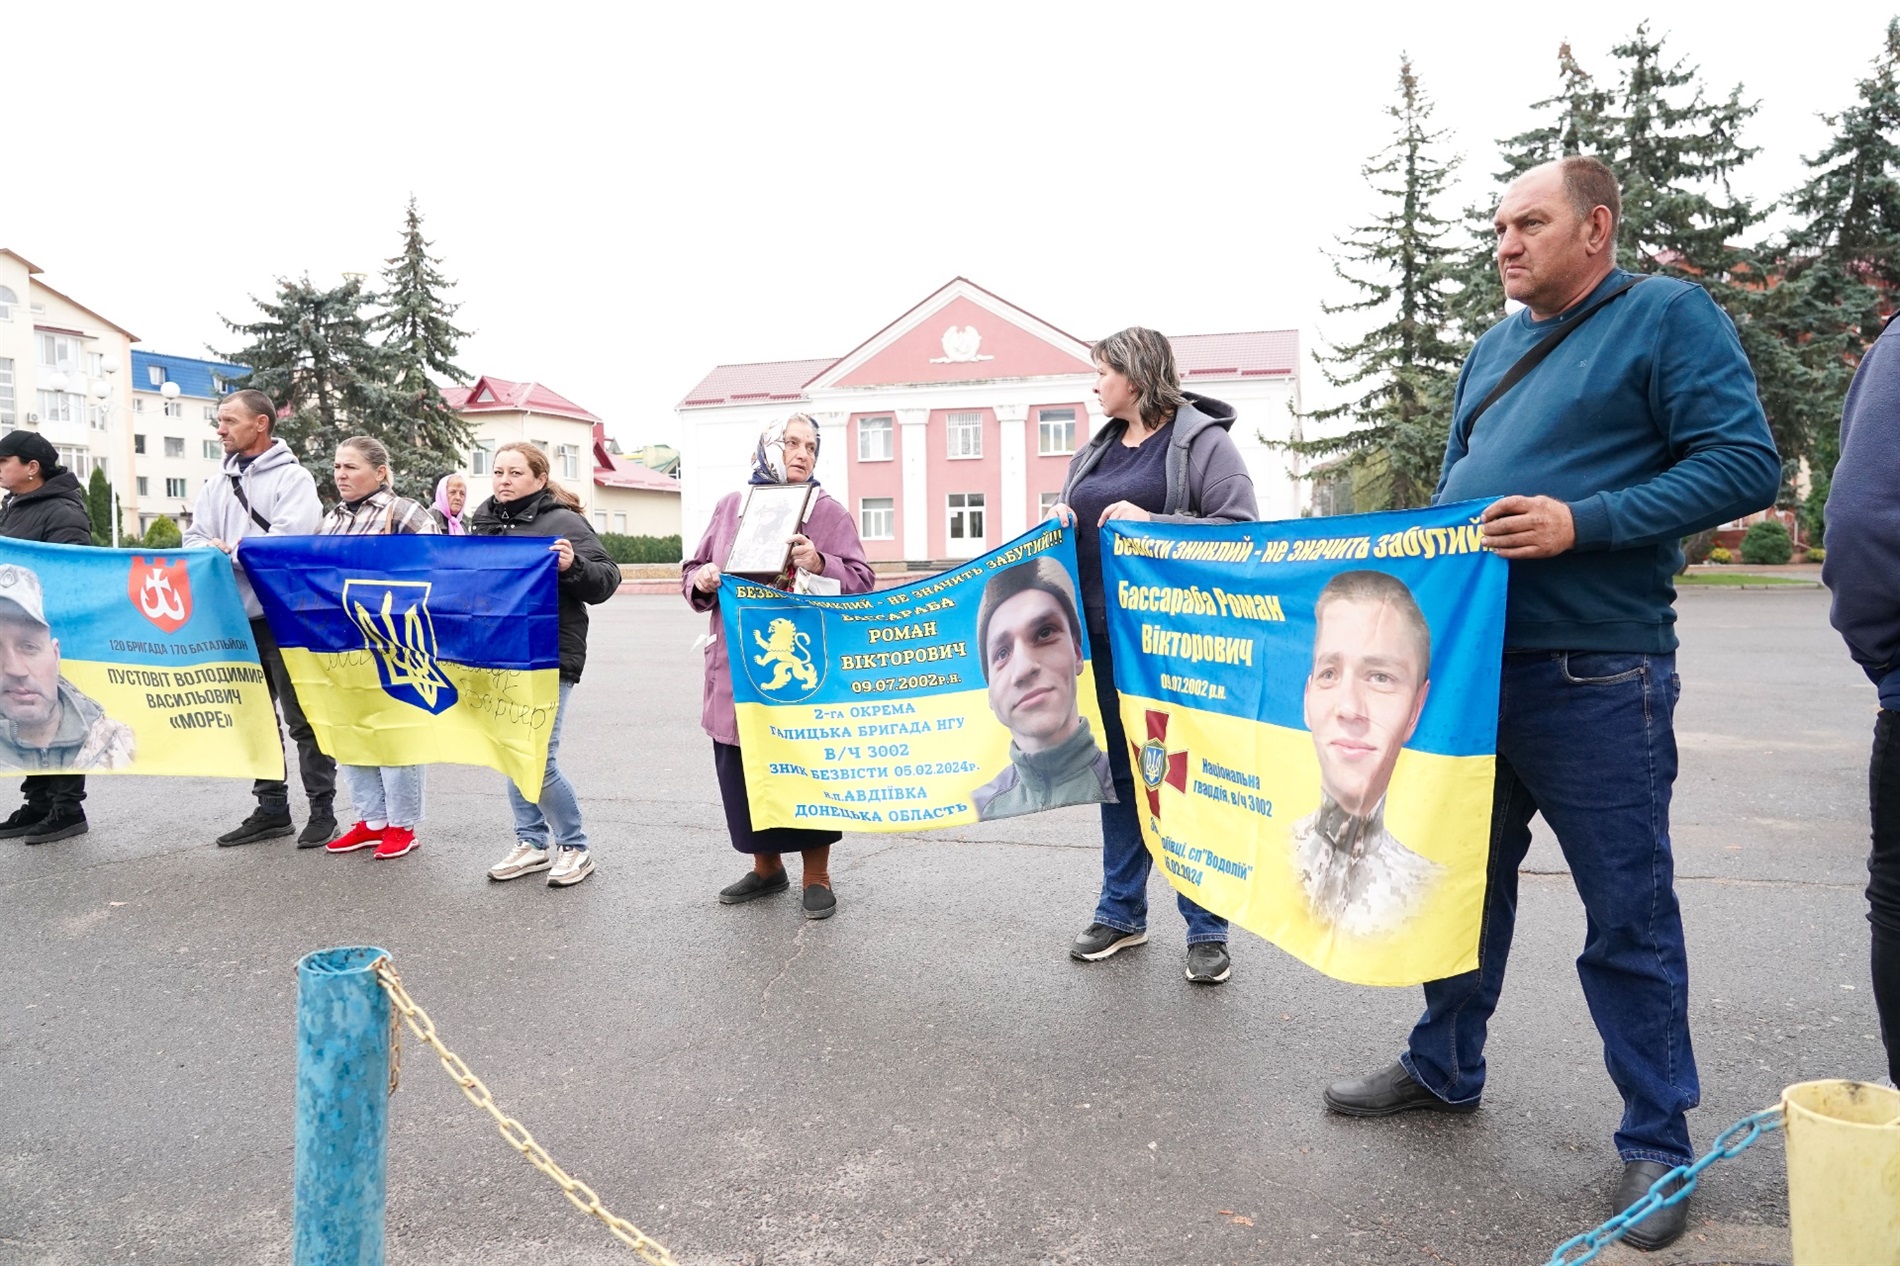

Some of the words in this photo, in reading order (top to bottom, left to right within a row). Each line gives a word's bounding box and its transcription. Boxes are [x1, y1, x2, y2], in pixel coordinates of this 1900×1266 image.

[1172, 535, 1254, 563] зниклий
[1260, 540, 1289, 563] не
[1287, 535, 1371, 562] значить
[887, 593, 910, 606] НЕ
[912, 566, 984, 599] ЗНАЧИТЬ
[986, 529, 1064, 570] ЗАБУТИЙ!!!
[1118, 580, 1217, 616] Бассараба
[1212, 587, 1286, 622] Роман
[868, 621, 938, 644] РОМАН
[109, 639, 125, 651] 120
[126, 641, 169, 656] БРИГАДА
[169, 644, 187, 655] 170
[190, 639, 249, 654] БАТАЛЬЙОН
[841, 642, 967, 670] ВІКТОРОВИЧ
[1141, 624, 1254, 667] Вікторович
[107, 668, 171, 688] ПУСТОВІТ
[174, 667, 264, 688] ВОЛОДИМИР
[1160, 673, 1209, 697] 09.07.2002
[1208, 683, 1227, 700] р.н.
[146, 689, 242, 709] ВАСИЛЬОВИЧ
[850, 702, 916, 718] ОКРЕМА
[170, 710, 233, 730] «МОРЕ»
[770, 725, 852, 741] ГАЛИЦЬКА
[858, 720, 931, 738] БРИГАДА
[937, 717, 966, 731] НГУ
[824, 746, 861, 762] В/Ч
[867, 744, 910, 759] 3002
[769, 763, 809, 777] ЗНИК
[811, 766, 889, 781] БЕЗВІСТИ
[1202, 758, 1261, 790] Національна
[1193, 780, 1230, 804] гвардія,
[1230, 791, 1248, 809] в/ч
[1248, 794, 1273, 818] 3002
[795, 804, 883, 823] ДОНЕЦЬКА
[888, 803, 968, 822] ОБЛАСТЬ
